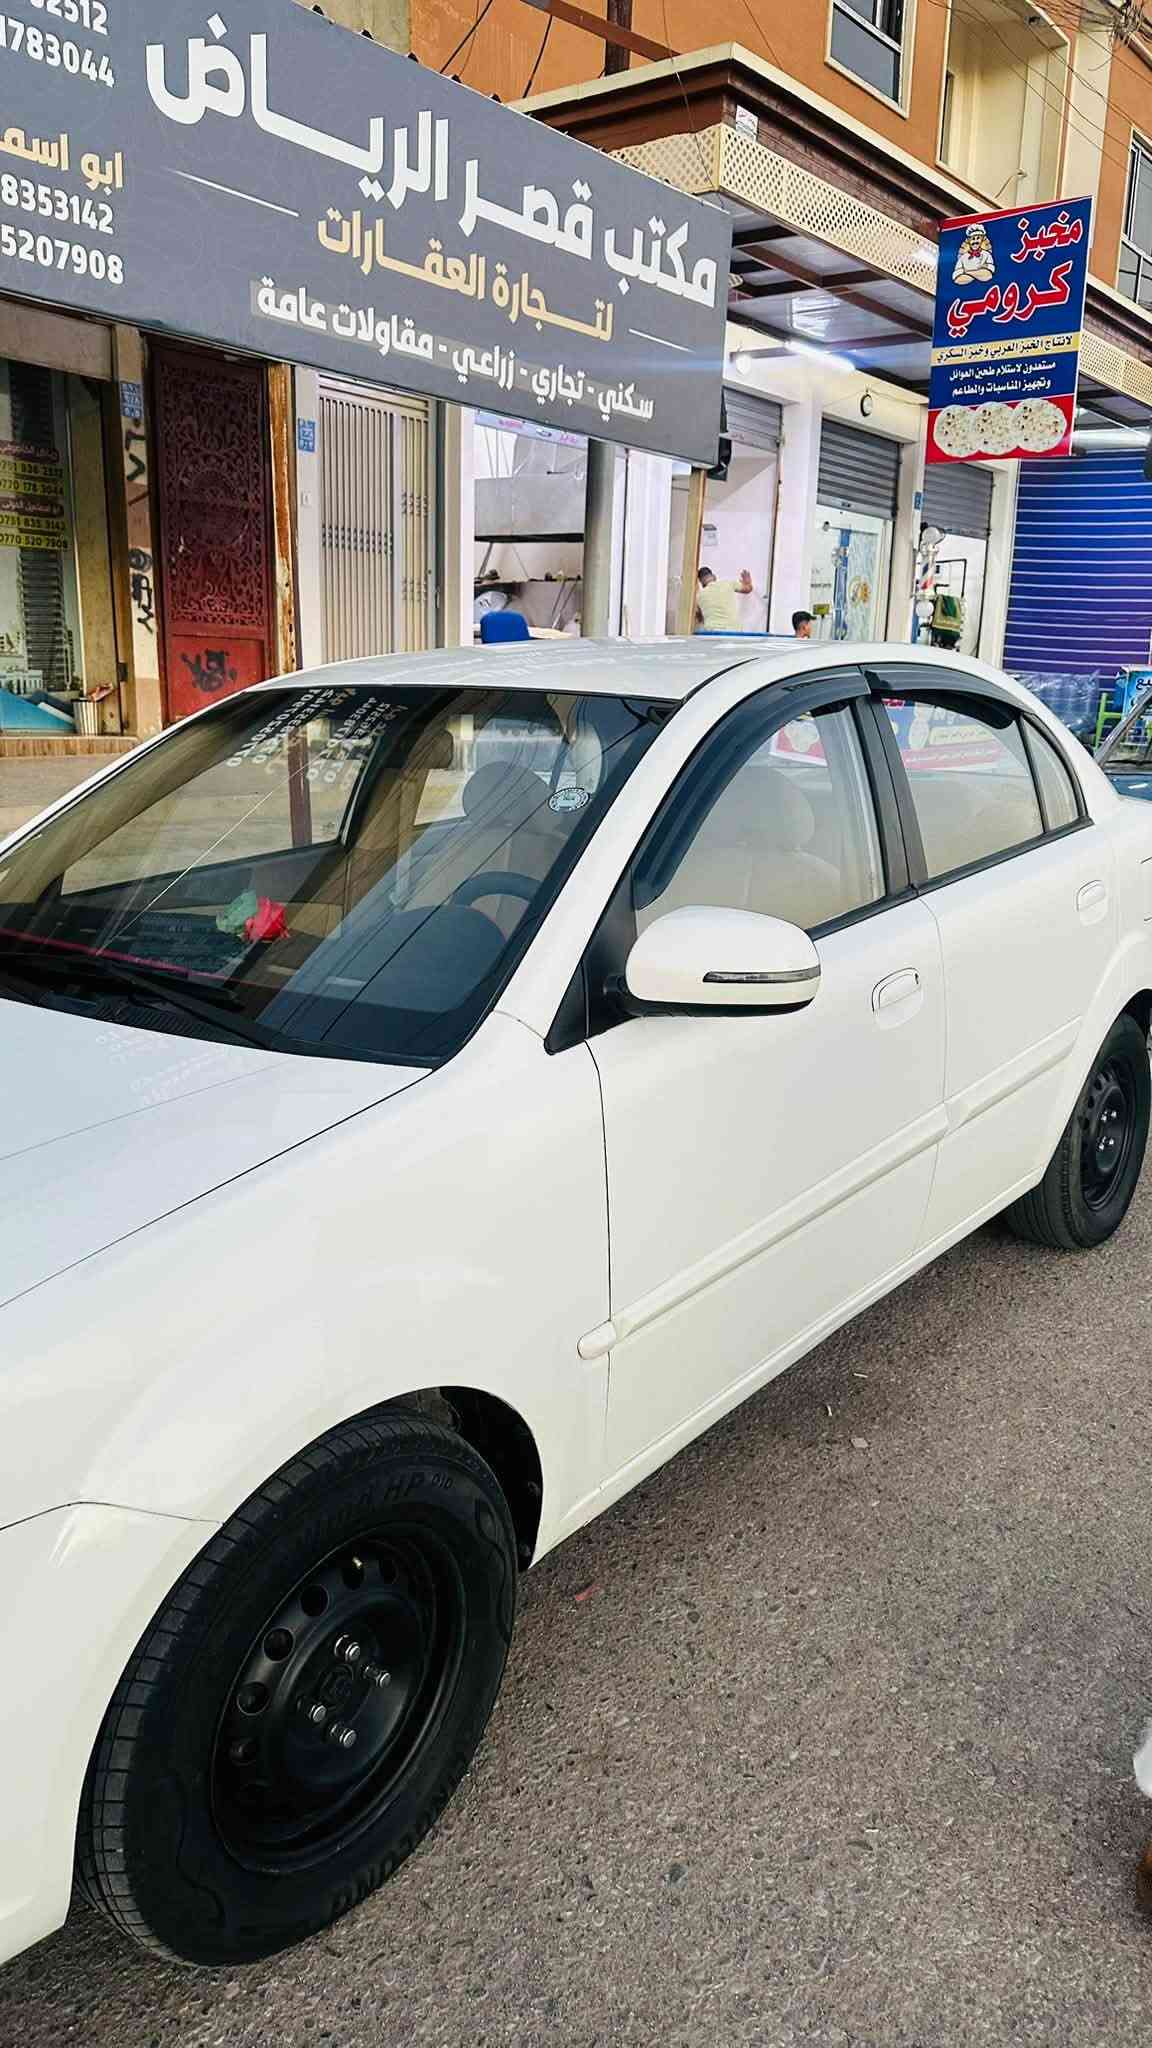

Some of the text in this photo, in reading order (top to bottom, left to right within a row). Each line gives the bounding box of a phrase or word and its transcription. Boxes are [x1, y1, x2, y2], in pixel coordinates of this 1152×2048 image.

[29, 0, 108, 36] 2512
[0, 127, 124, 196] ابو اسم
[146, 13, 718, 308] مكتب قصر الرياض
[0, 173, 114, 234] 8353142
[0, 224, 124, 285] 5207908
[317, 207, 486, 301] العقارات
[1011, 211, 1083, 263] مخبز
[257, 275, 328, 331] عامة
[947, 260, 1073, 338] كرومي
[332, 304, 434, 360] مقاولات
[991, 343, 1018, 358] العربي
[1020, 339, 1043, 353] الخبز
[452, 345, 516, 391] زراعي
[531, 370, 586, 407] تجاري
[986, 380, 1021, 393] المناسبات
[996, 363, 1022, 377] لاستلام
[1022, 361, 1056, 375] مستعدون
[1023, 377, 1051, 392] وتجهيز
[597, 382, 654, 422] سكني
